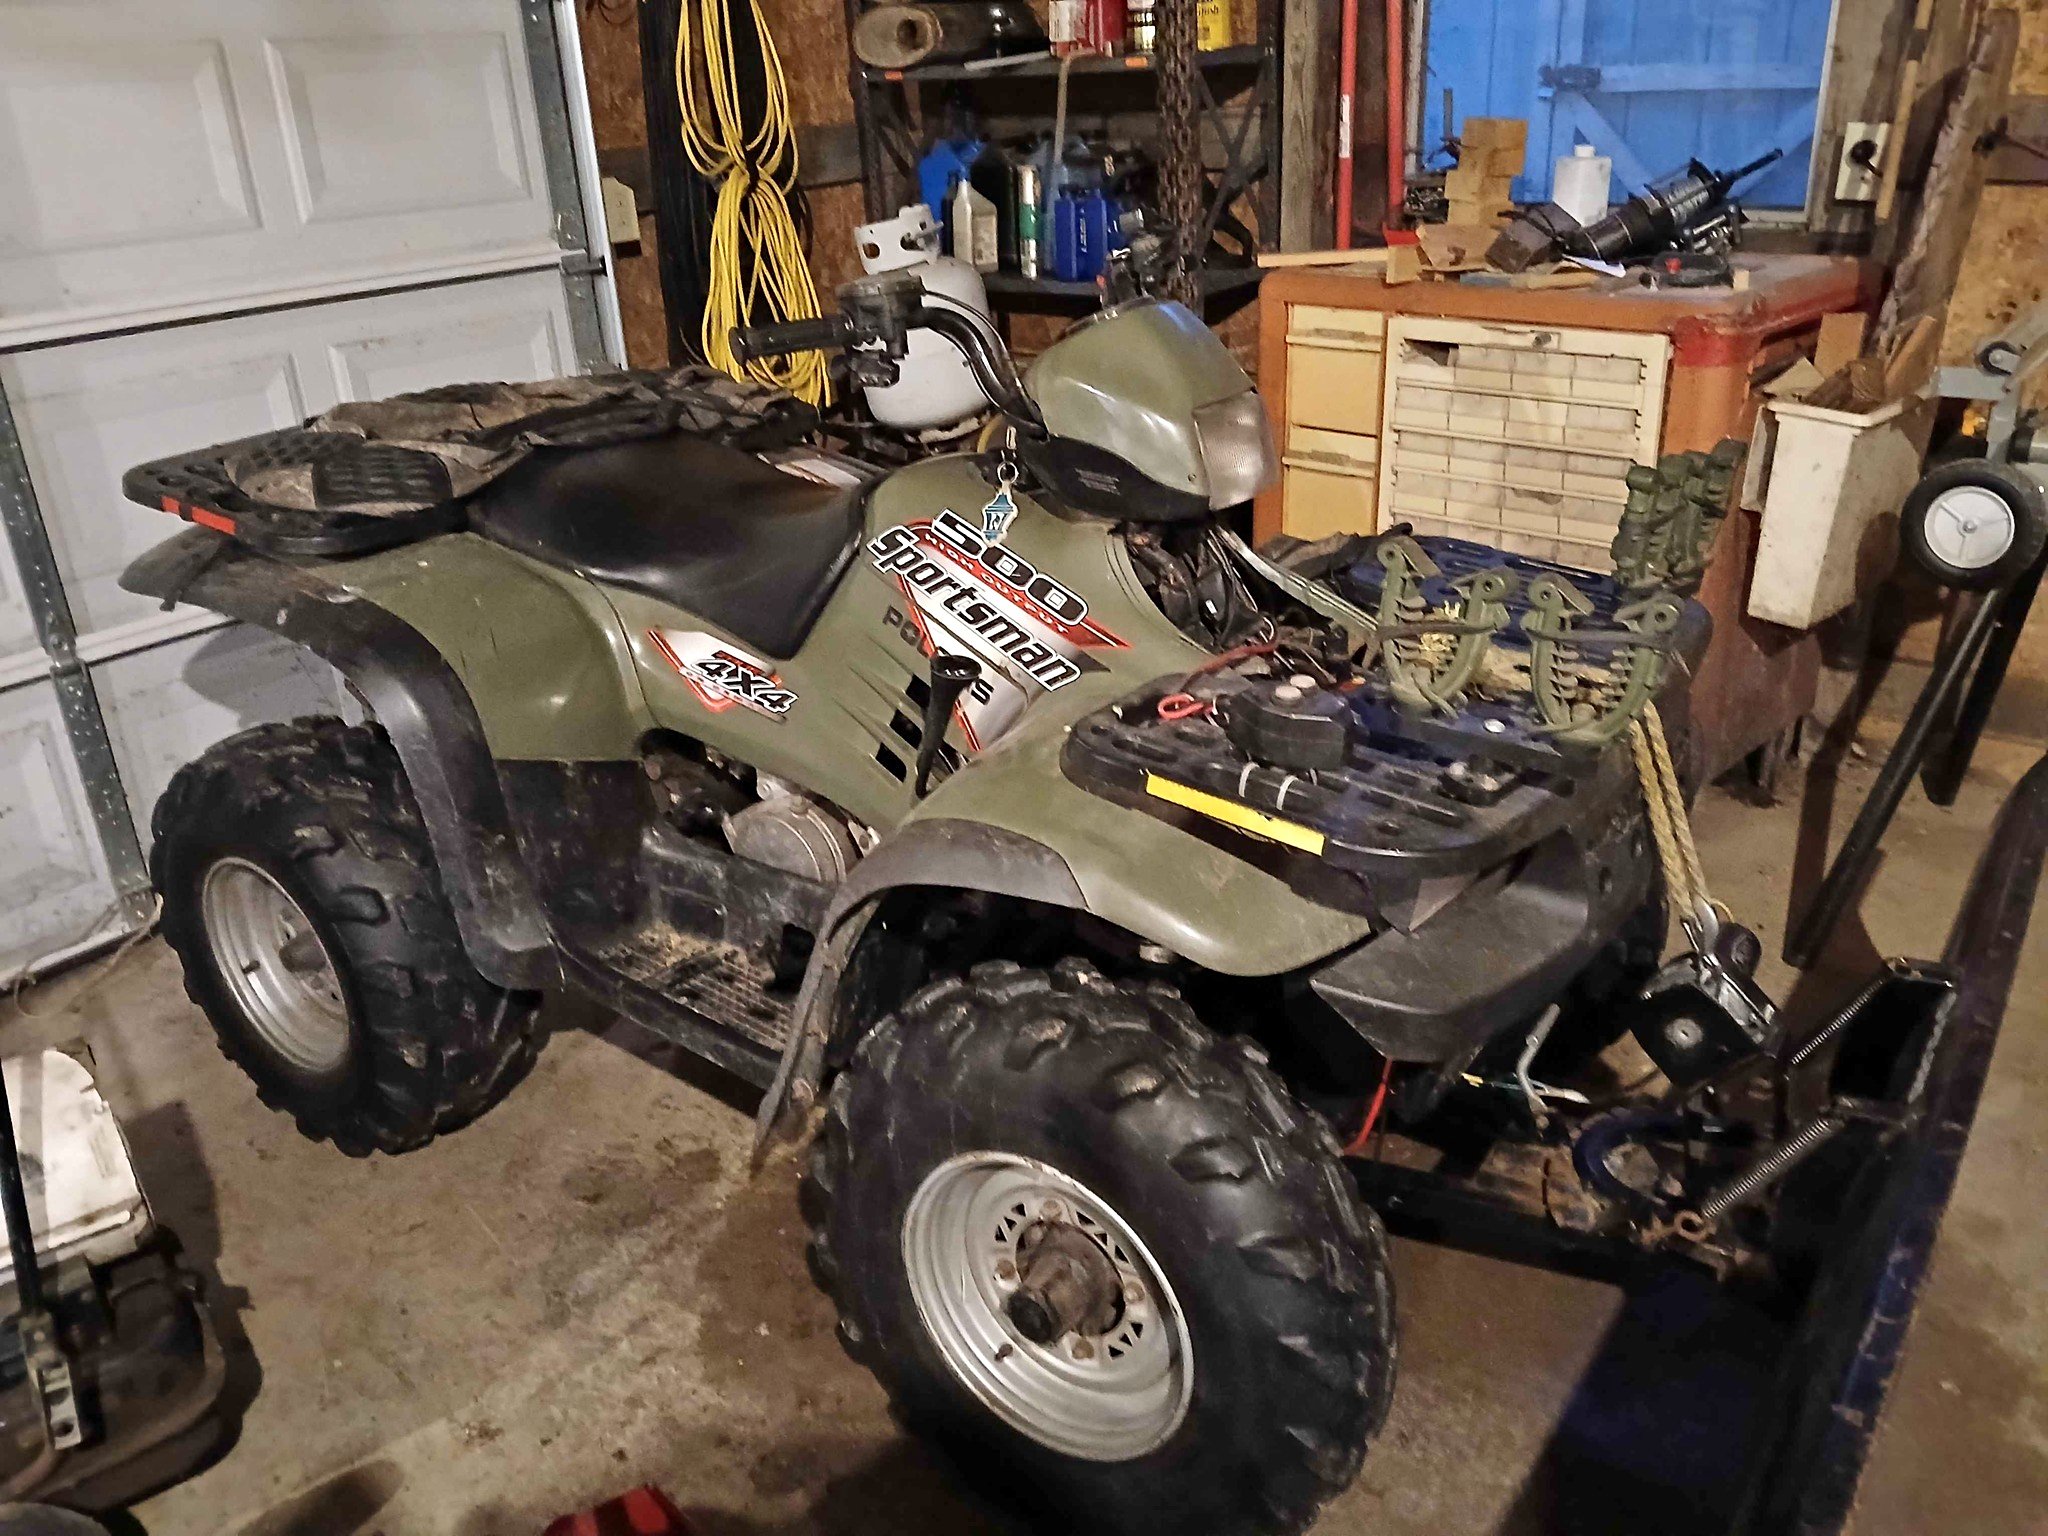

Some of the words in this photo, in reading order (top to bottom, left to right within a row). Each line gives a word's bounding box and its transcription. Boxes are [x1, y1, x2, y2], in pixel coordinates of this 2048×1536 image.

[867, 526, 1081, 691] Sportsman
[924, 533, 974, 570] HIGH
[980, 571, 1069, 634] OUTPUT
[932, 509, 1088, 625] 500
[882, 605, 995, 705] POLS
